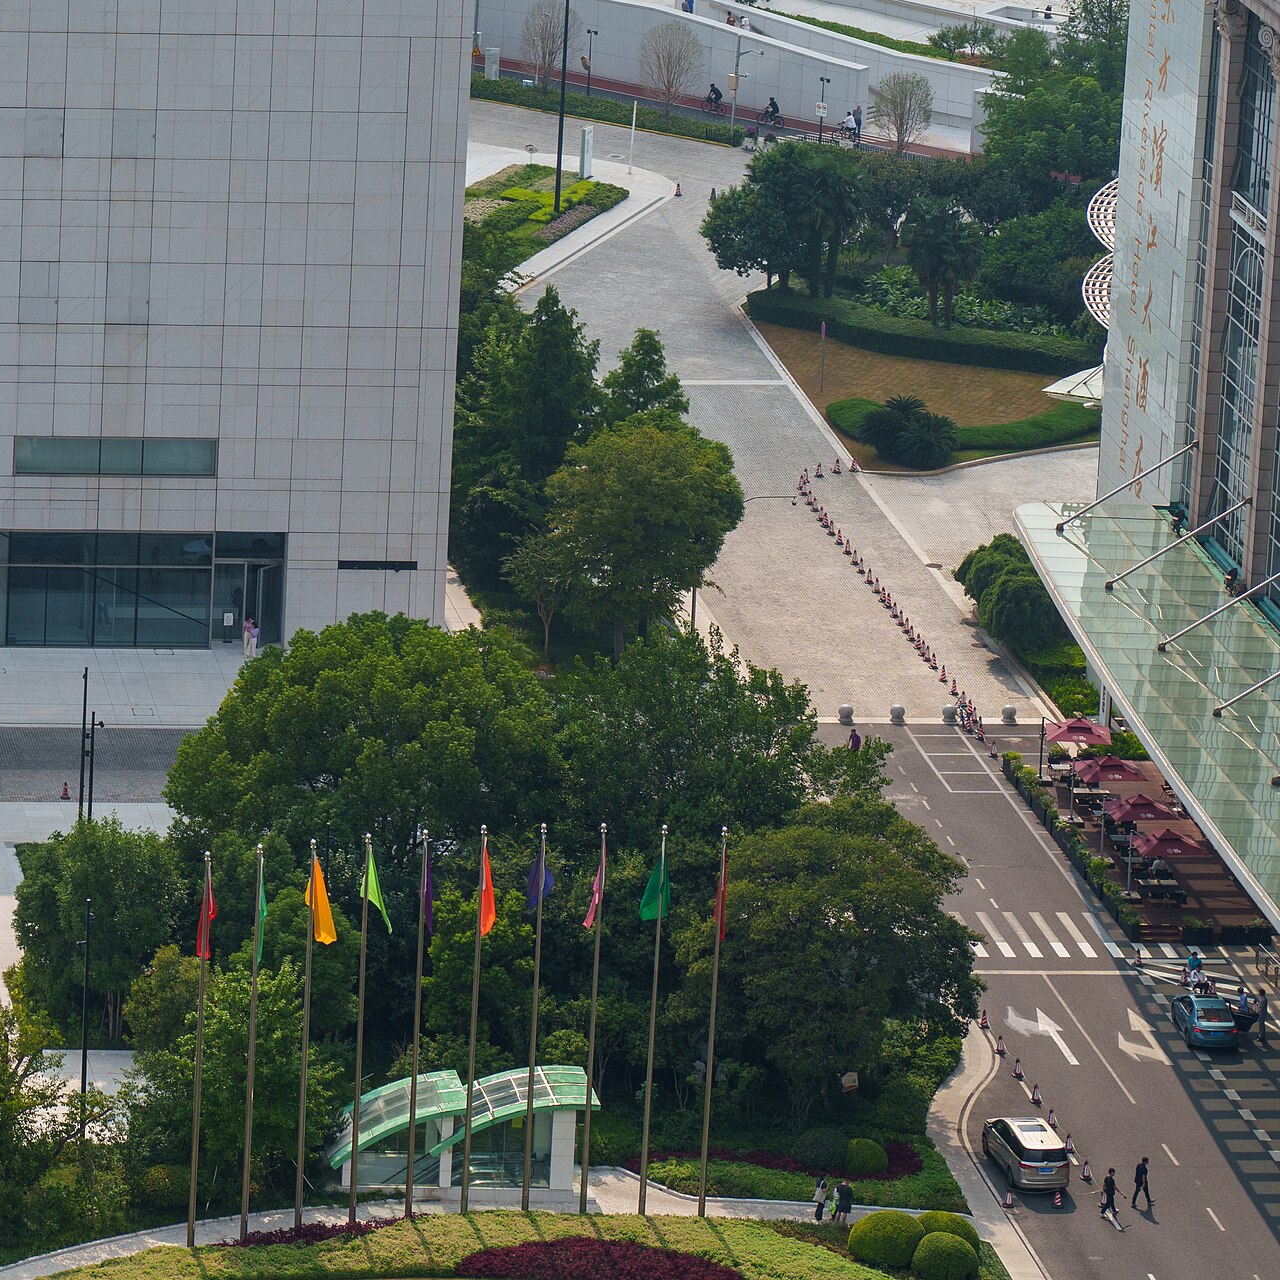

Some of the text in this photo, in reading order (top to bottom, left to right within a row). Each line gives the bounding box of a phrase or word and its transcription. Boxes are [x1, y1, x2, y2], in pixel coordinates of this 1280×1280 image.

[1135, 78, 1153, 217] Riverside
[1129, 236, 1143, 317] Hotel
[1118, 334, 1136, 474] Shanghai
